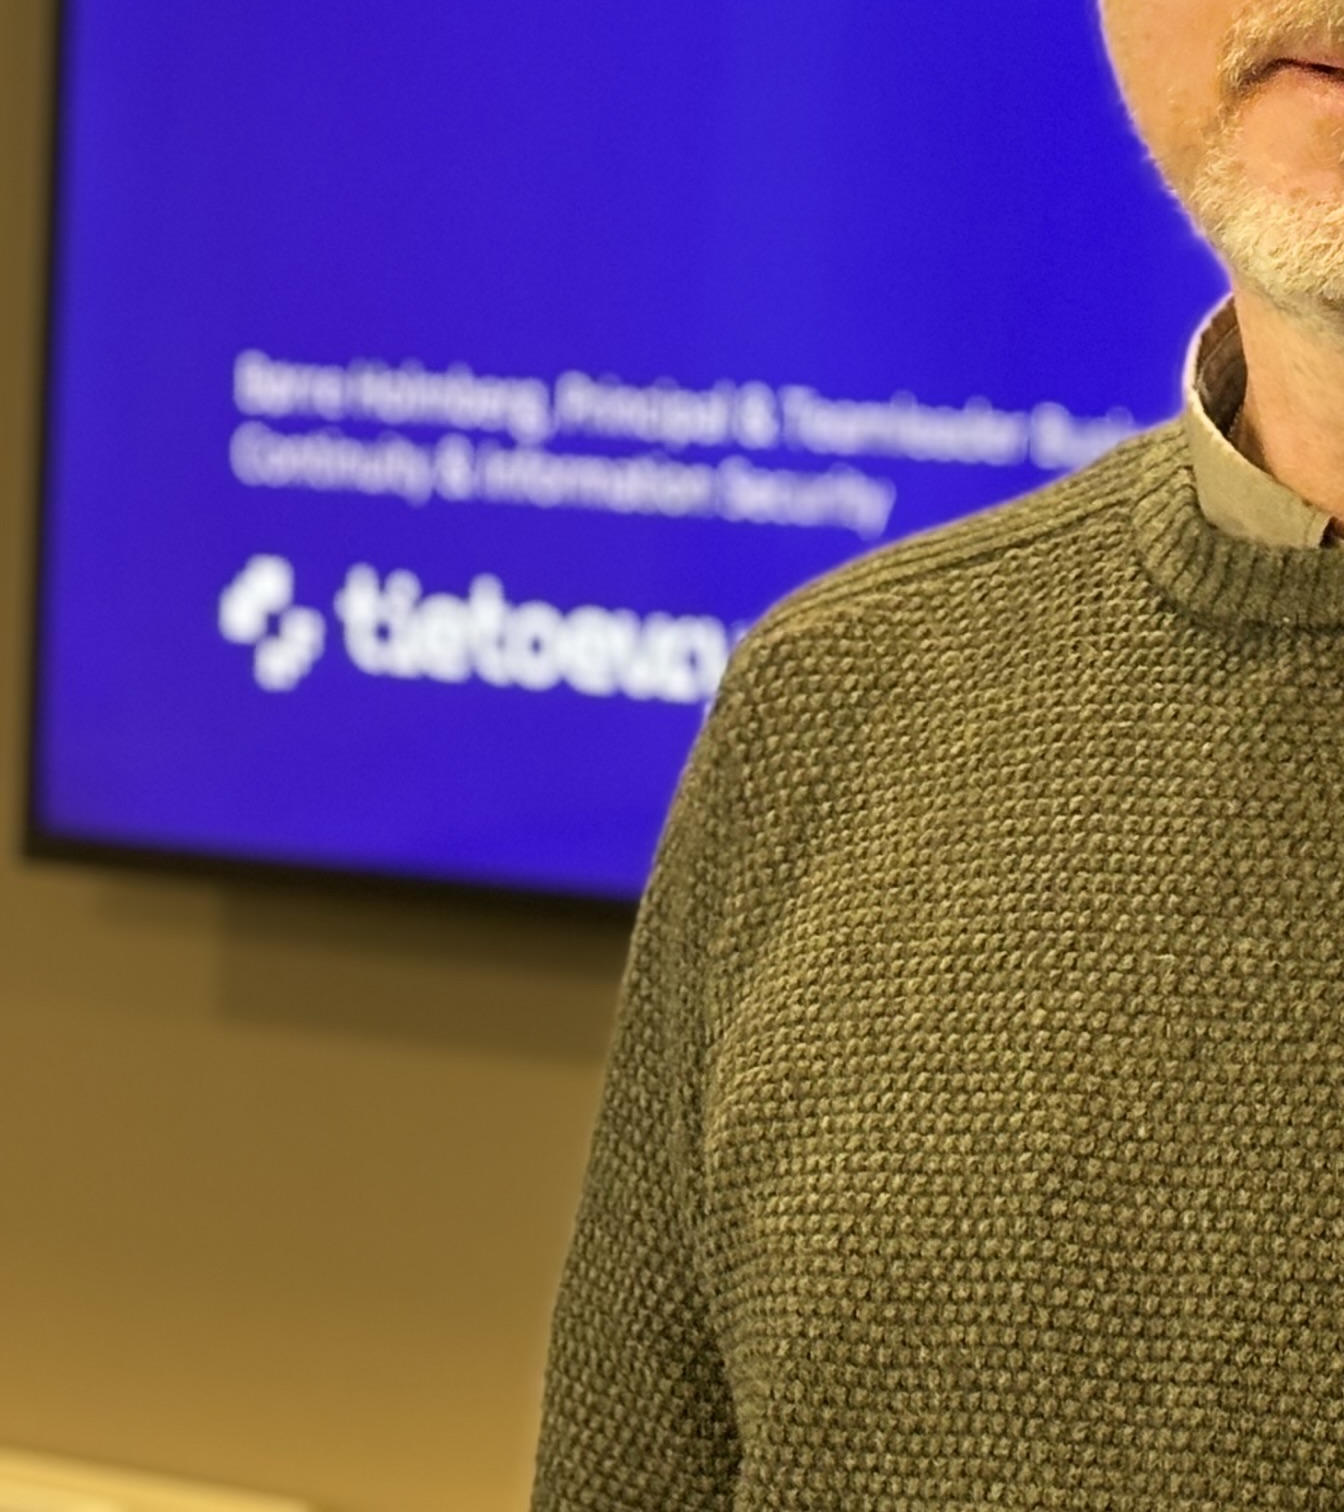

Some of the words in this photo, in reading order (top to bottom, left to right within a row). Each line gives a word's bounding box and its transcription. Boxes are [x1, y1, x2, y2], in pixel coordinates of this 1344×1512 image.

[735, 380, 776, 449] &
[230, 421, 432, 508] Continuity
[435, 432, 475, 501] &
[717, 455, 896, 541] Security
